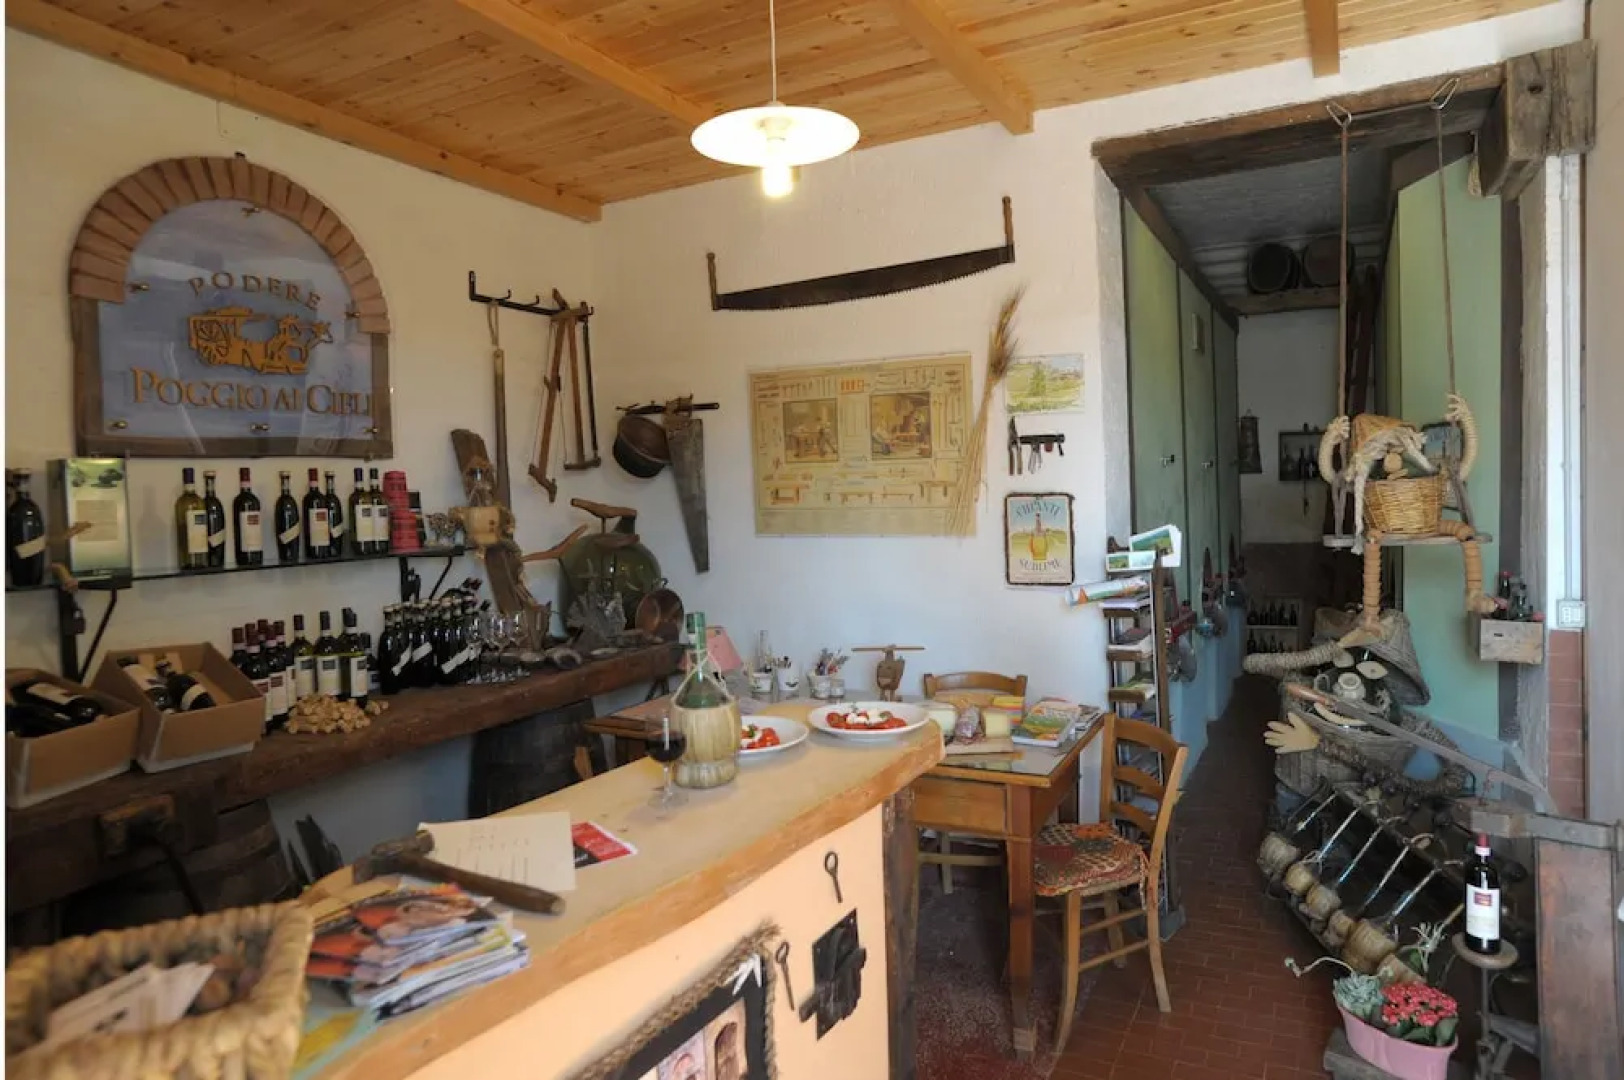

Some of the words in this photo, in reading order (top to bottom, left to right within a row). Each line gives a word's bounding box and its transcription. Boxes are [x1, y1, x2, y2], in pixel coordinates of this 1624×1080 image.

[189, 271, 321, 311] PODERE
[131, 367, 269, 411] POGGIO
[273, 386, 300, 411] AI
